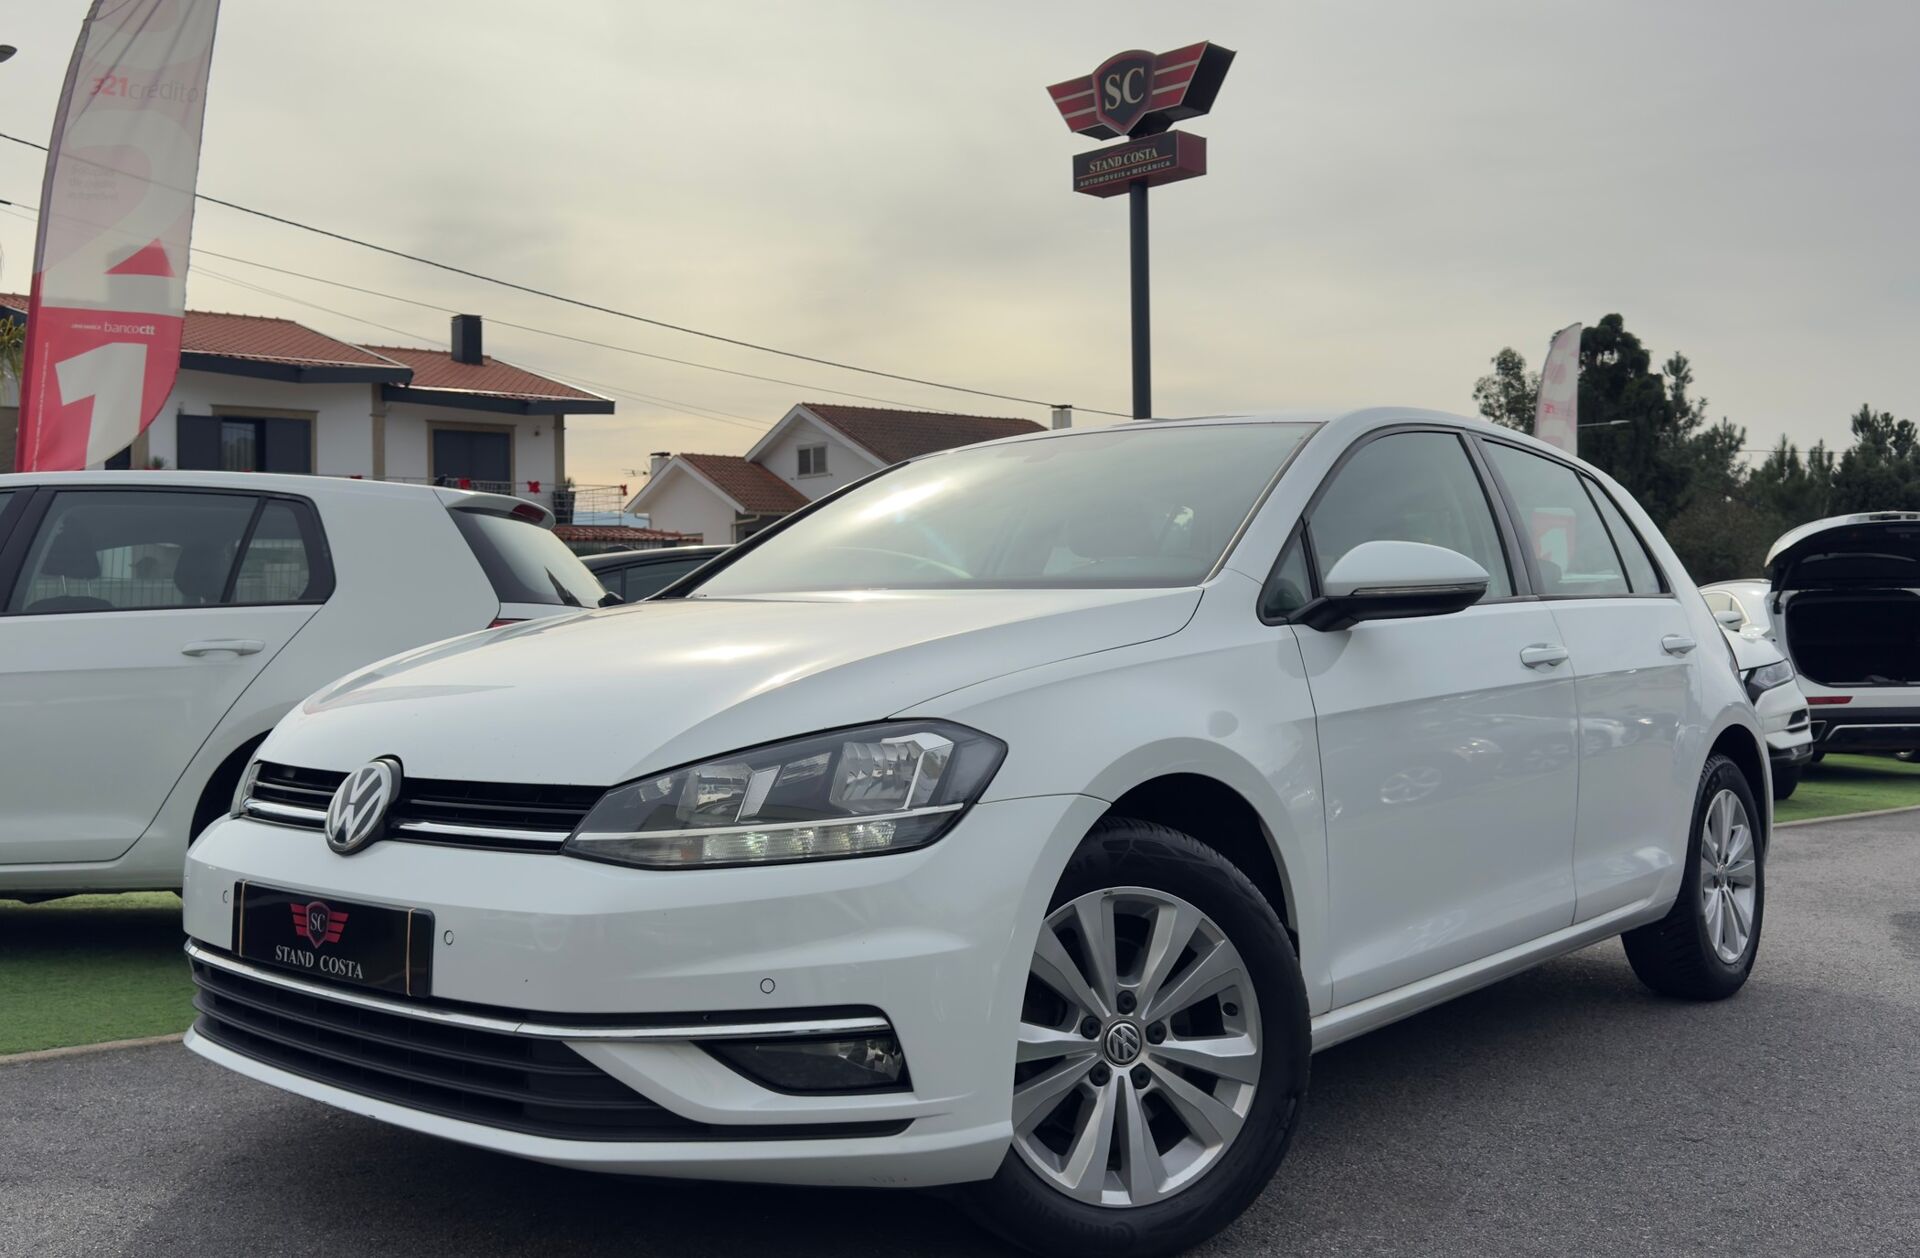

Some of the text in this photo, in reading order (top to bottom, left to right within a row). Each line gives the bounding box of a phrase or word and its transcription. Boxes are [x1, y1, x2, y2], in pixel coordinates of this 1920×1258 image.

[1104, 66, 1145, 111] SC
[1088, 147, 1158, 174] STAND COSTA
[310, 912, 326, 933] SC
[275, 944, 364, 980] STAND COSTA
